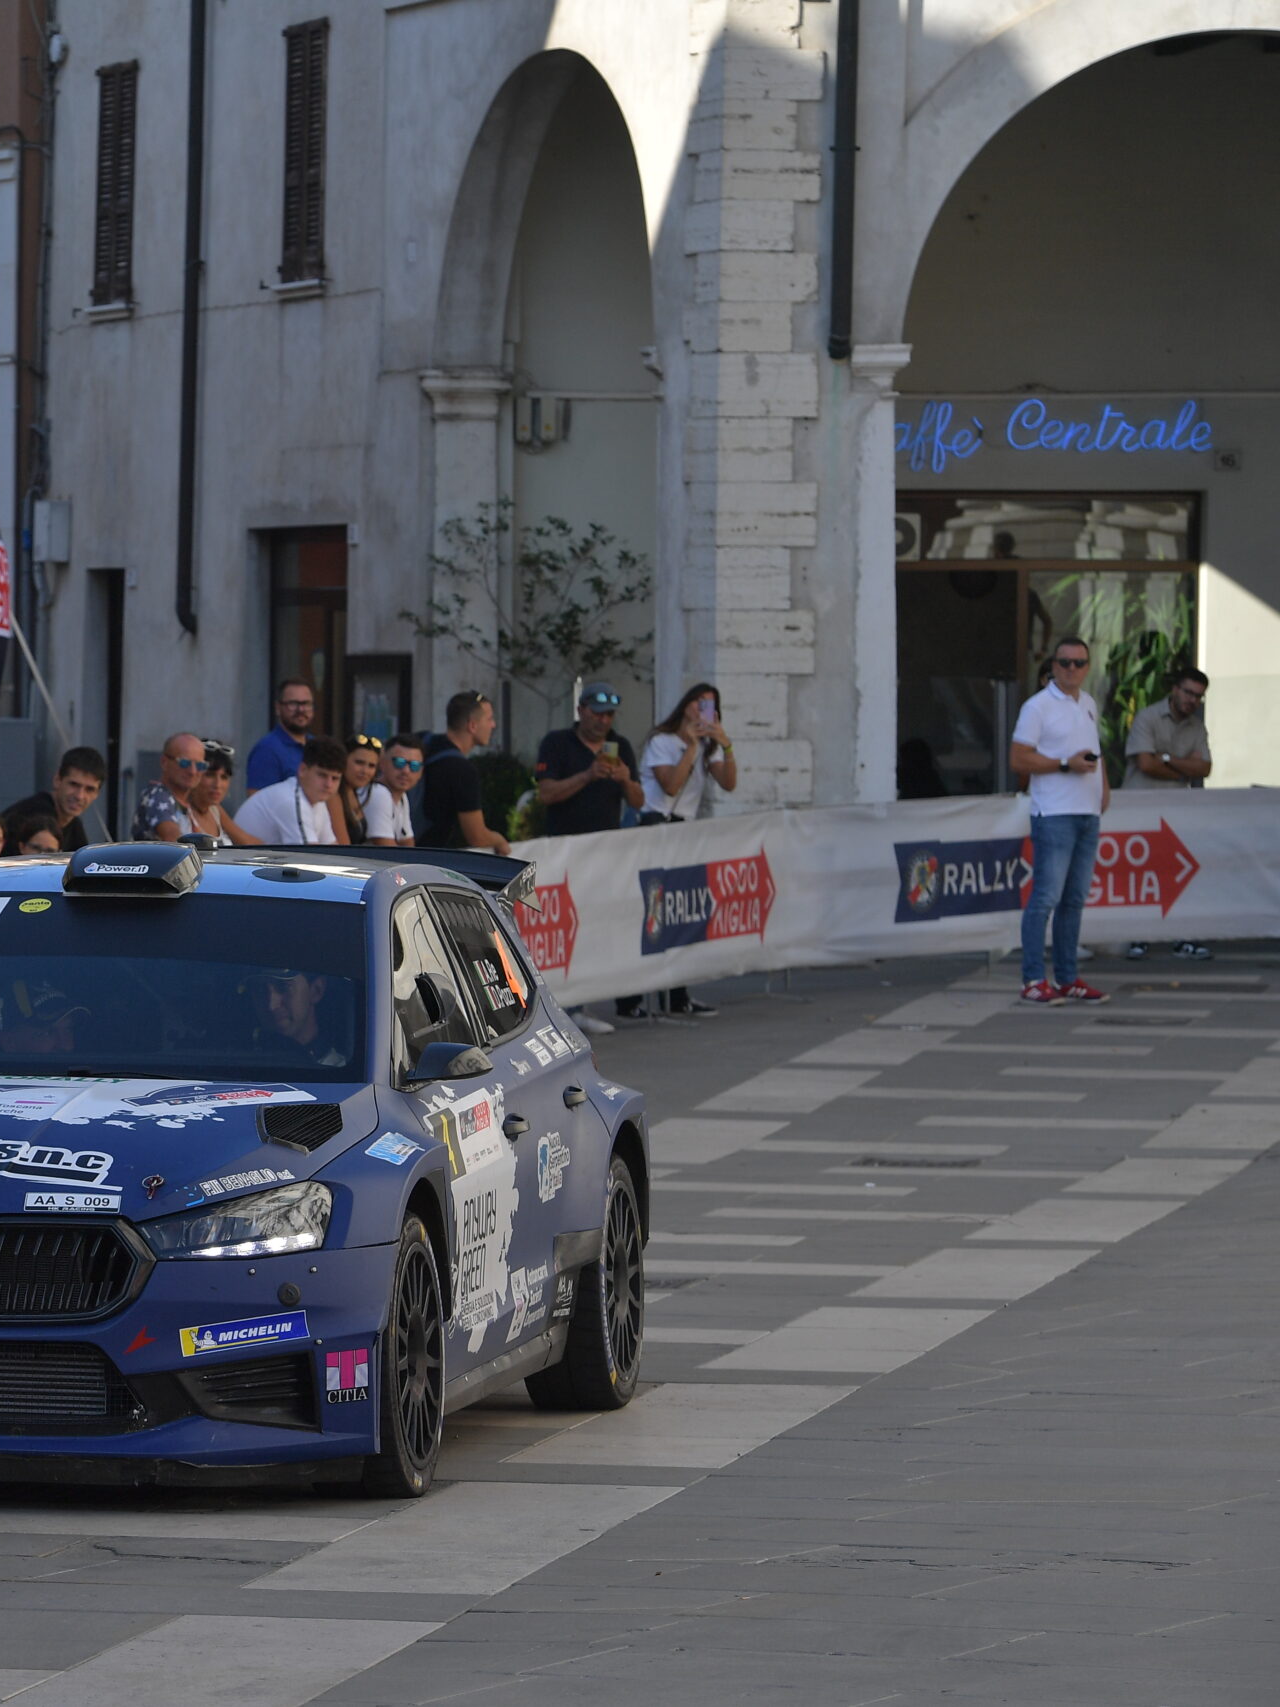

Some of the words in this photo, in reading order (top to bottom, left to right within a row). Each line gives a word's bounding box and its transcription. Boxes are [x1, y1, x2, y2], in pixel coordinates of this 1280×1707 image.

[894, 400, 983, 474] affè
[1006, 398, 1214, 453] Centrale
[1096, 835, 1150, 867] 00
[943, 857, 1019, 897] RALLY
[1086, 869, 1161, 905] GLIA
[665, 887, 711, 925] RALLY
[219, 1168, 278, 1193] BENAGLIO
[33, 1195, 56, 1206] AA
[64, 1195, 76, 1206] S
[83, 1196, 111, 1207] 009
[218, 1321, 293, 1342] MICHELIN
[327, 1388, 369, 1404] CITIA
